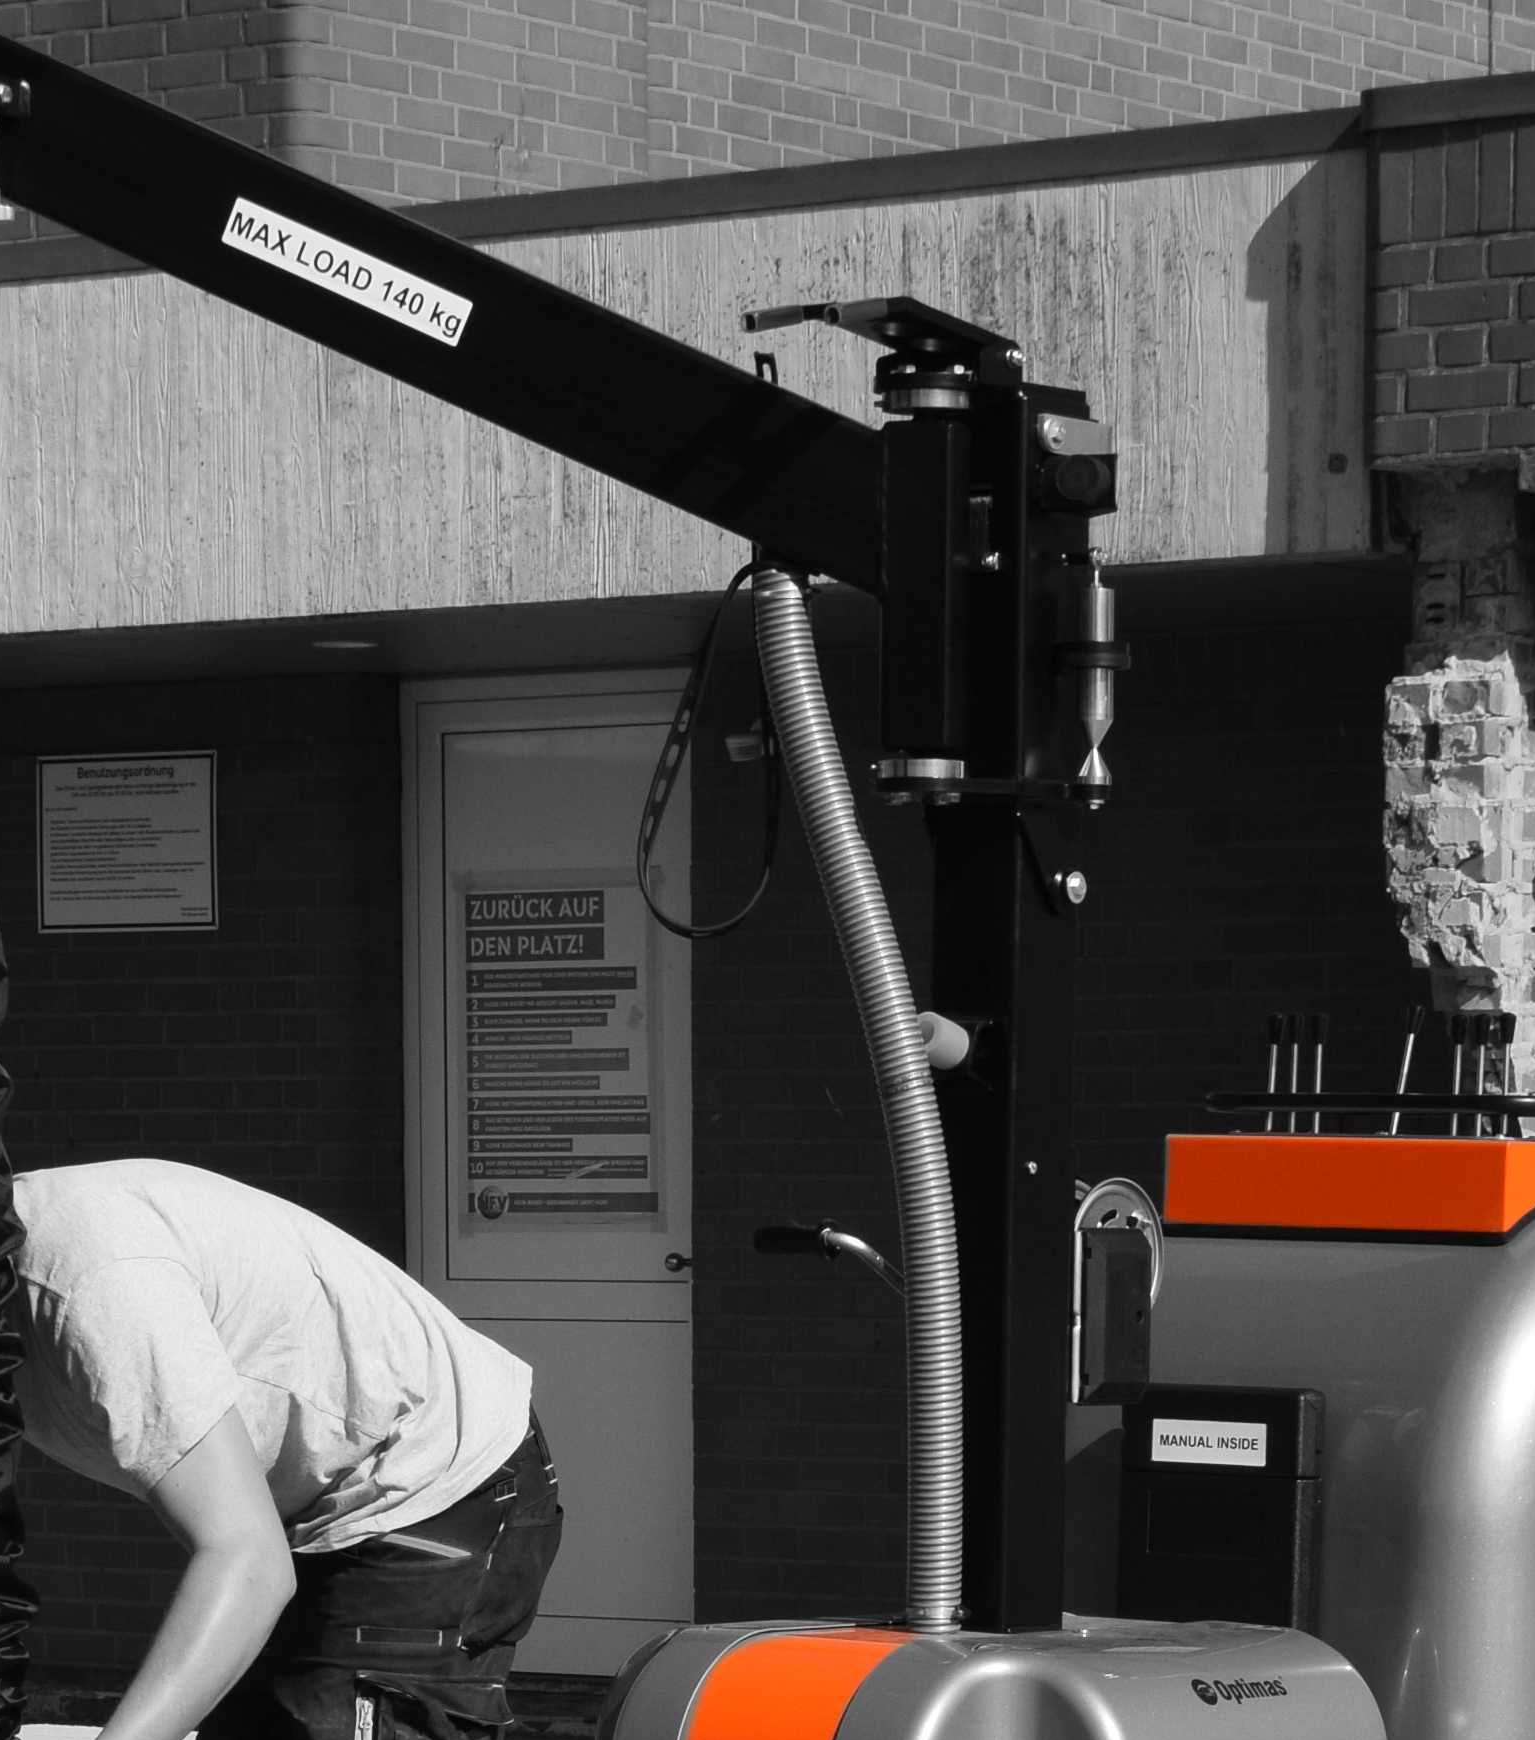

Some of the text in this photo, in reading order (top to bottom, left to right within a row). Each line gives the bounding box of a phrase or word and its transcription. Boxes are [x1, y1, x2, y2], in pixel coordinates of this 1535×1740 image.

[229, 211, 463, 339] MAX LOAD 140 kg
[77, 764, 174, 780] Benutzungsordnung
[469, 894, 600, 921] ZURÜCK AUF
[470, 933, 584, 957] DEN PLATZ!
[470, 975, 478, 987] 1
[471, 999, 479, 1011] 2
[471, 1015, 479, 1028] 3
[471, 1034, 479, 1045] 4
[472, 1056, 479, 1068] 5
[472, 1078, 479, 1090] 6
[472, 1098, 479, 1111] 7
[472, 1119, 480, 1131] 8
[472, 1140, 480, 1152] 9
[469, 1162, 484, 1174] 10
[1159, 1434, 1260, 1451] MANUAL INSIDE
[1213, 1677, 1288, 1704] Optimas
